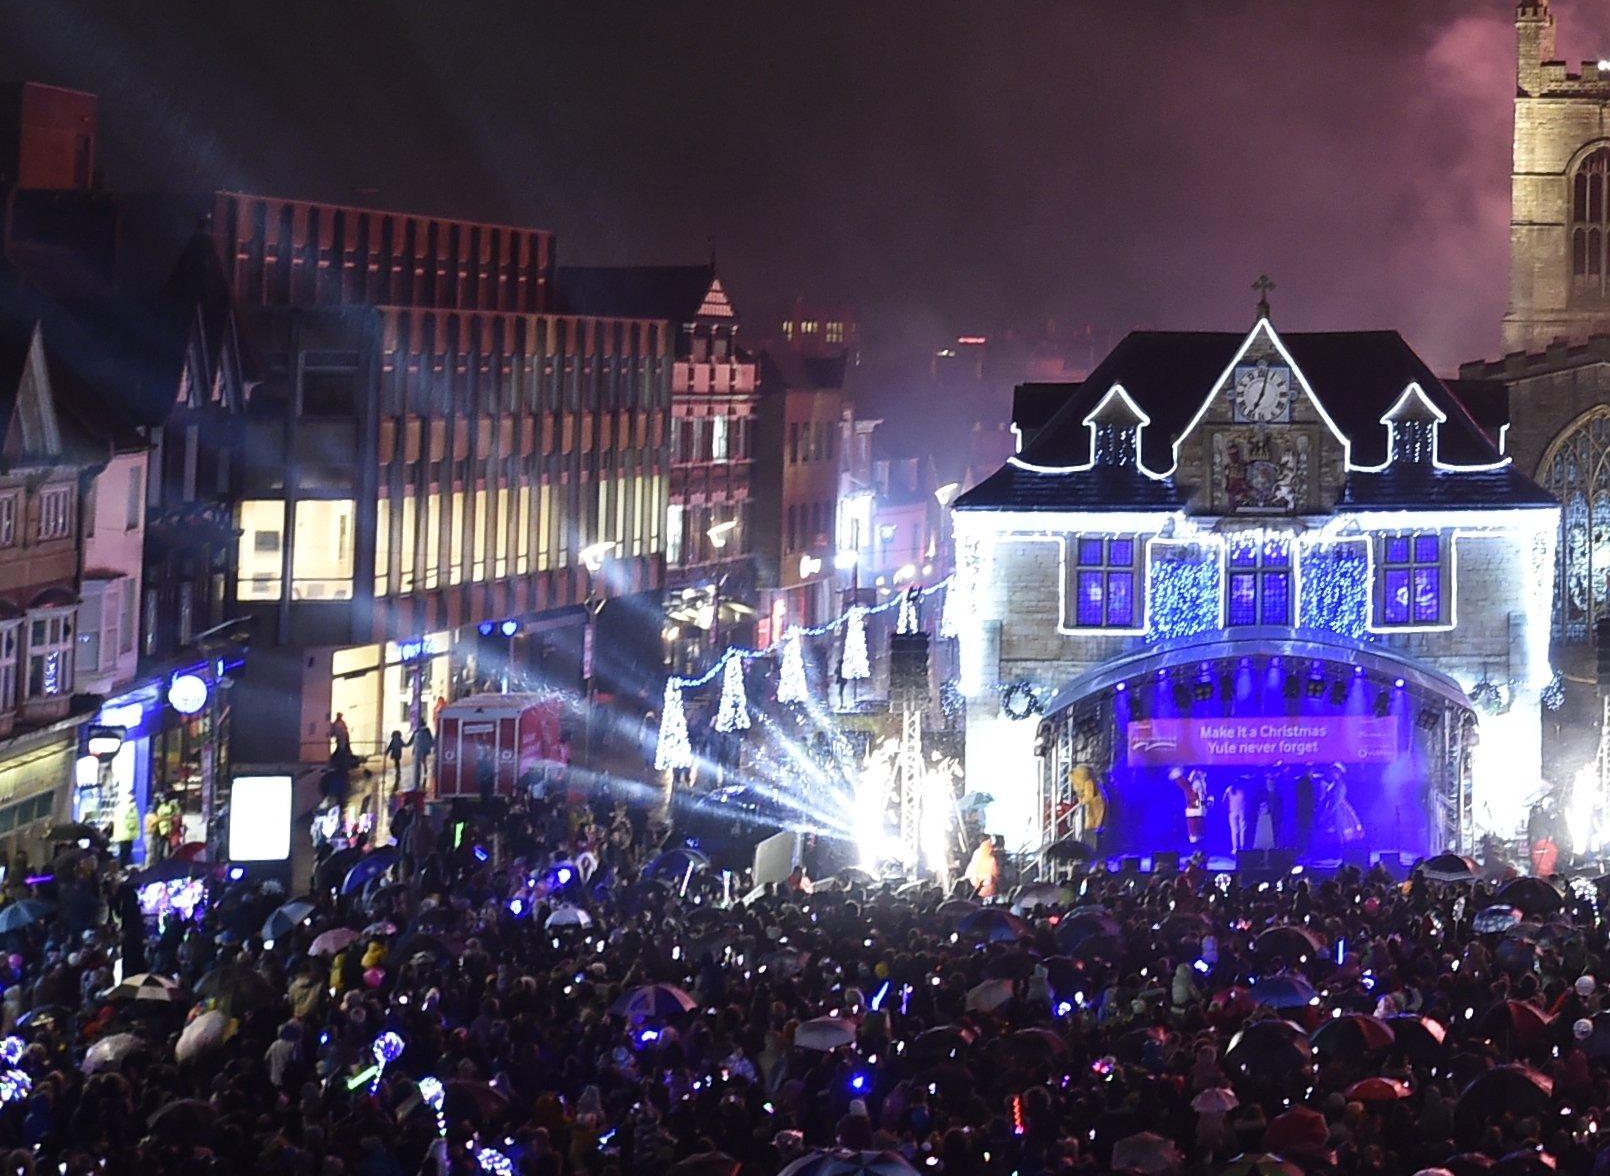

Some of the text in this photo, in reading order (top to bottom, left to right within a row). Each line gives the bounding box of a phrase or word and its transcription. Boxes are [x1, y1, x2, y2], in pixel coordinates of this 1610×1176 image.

[1200, 726, 1235, 739] Make
[1249, 728, 1258, 738] a
[1260, 725, 1327, 738] Christmas
[1208, 740, 1320, 756] Yule never forget
